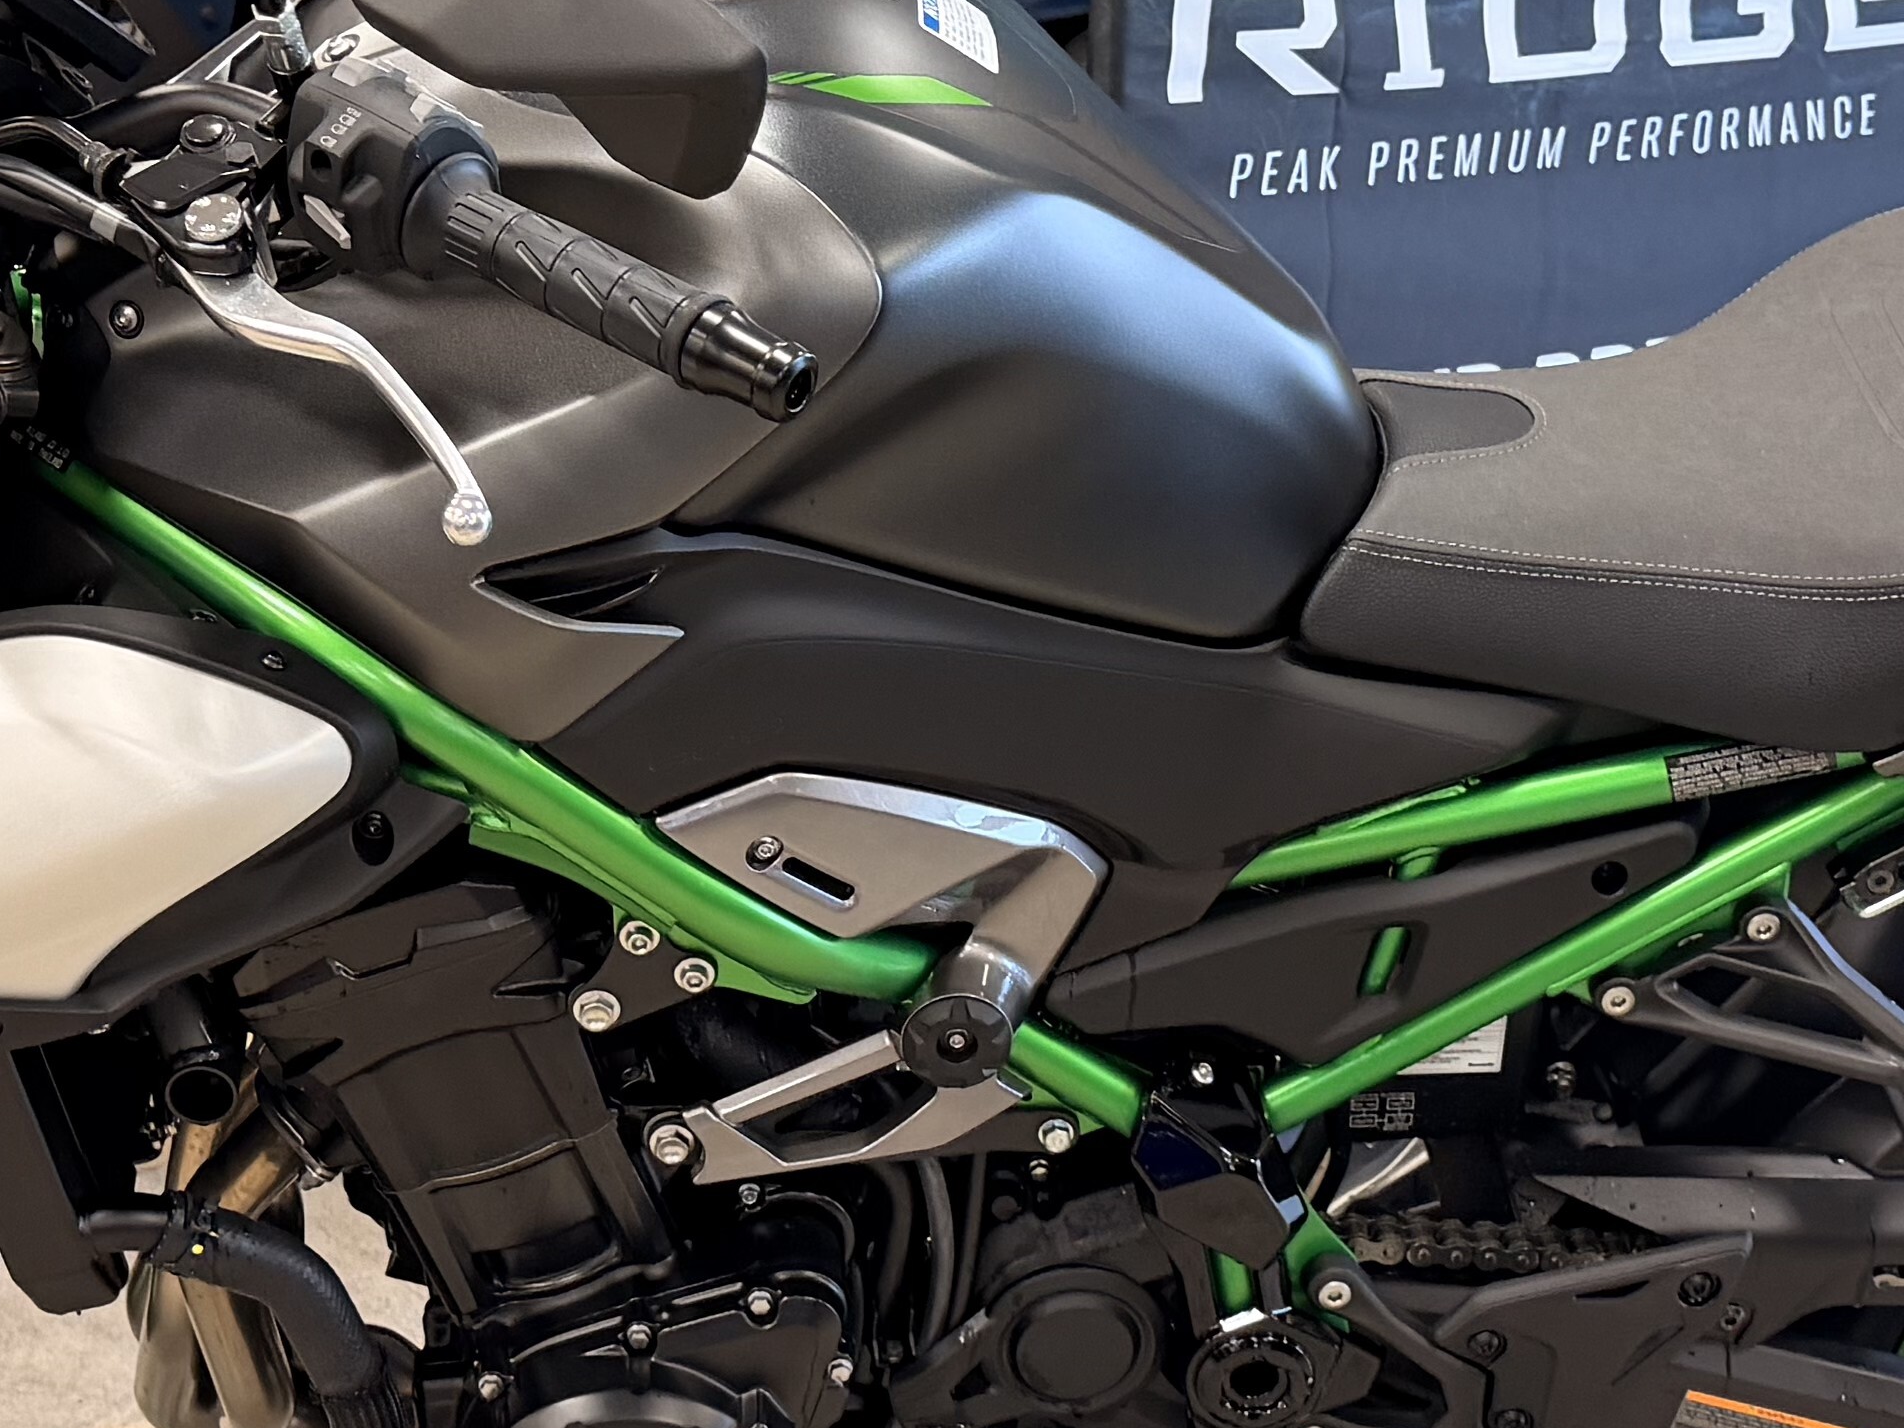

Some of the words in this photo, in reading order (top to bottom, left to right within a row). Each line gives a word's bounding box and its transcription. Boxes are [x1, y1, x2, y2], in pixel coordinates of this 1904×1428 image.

[1228, 144, 1342, 199] PEAK
[1368, 125, 1567, 188] PREMIUM
[1588, 92, 1879, 166] PERFORMANCE
